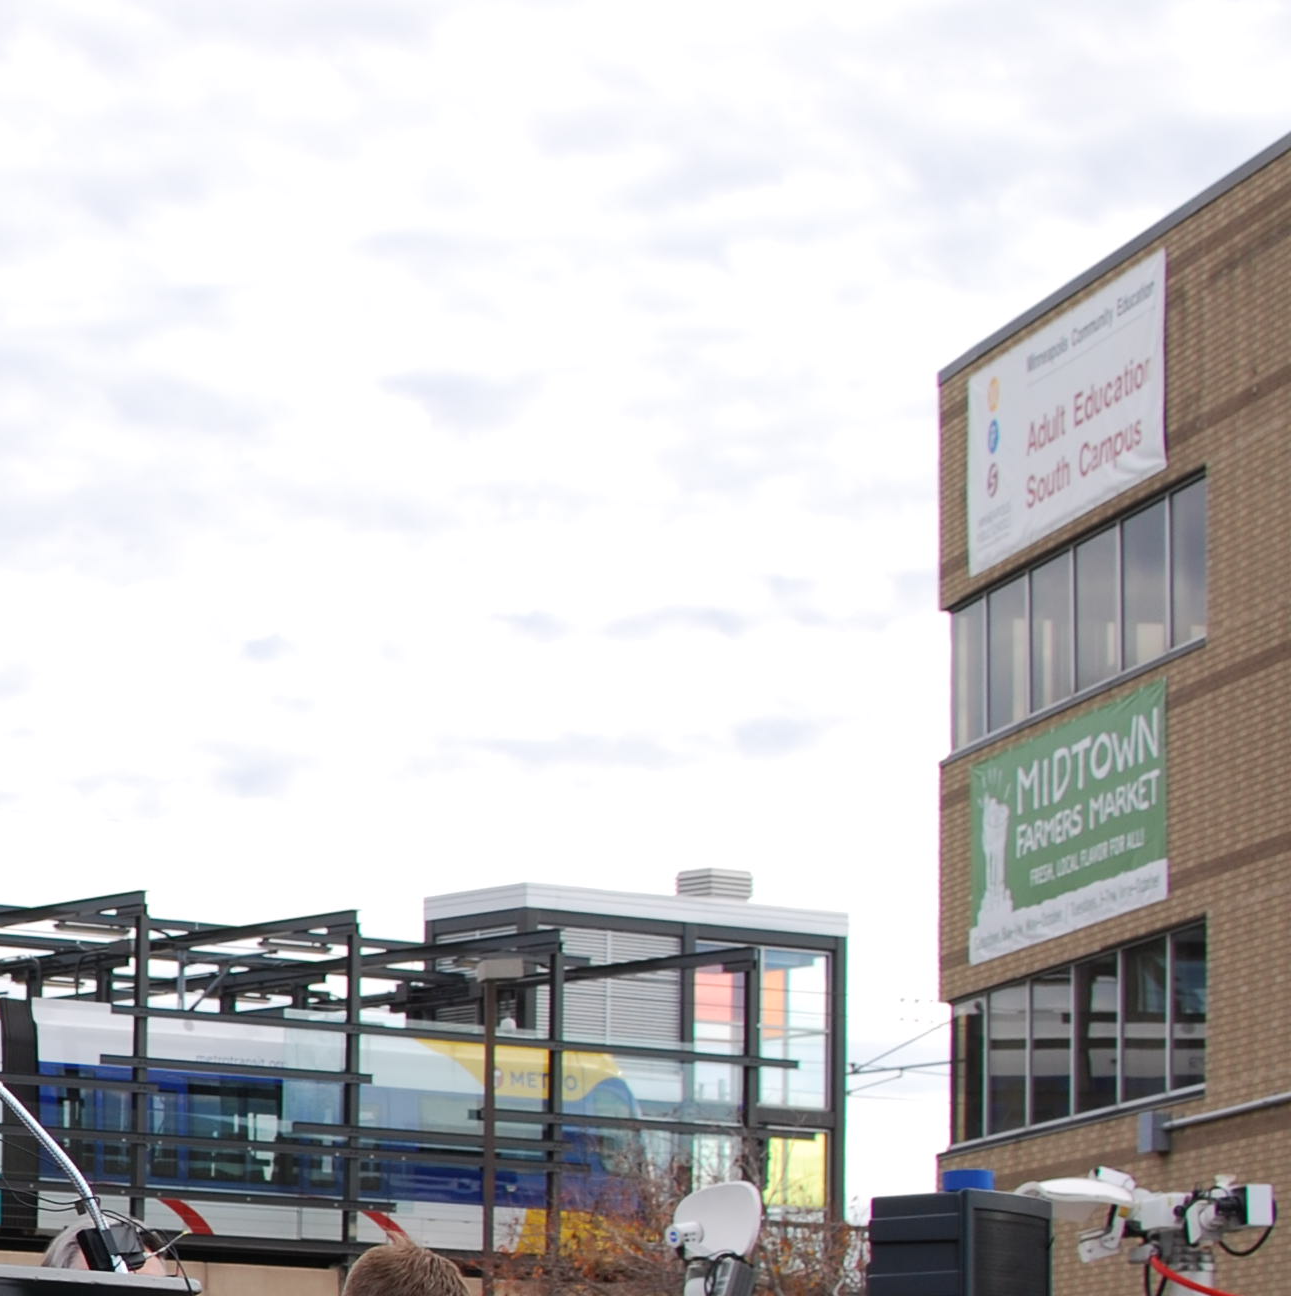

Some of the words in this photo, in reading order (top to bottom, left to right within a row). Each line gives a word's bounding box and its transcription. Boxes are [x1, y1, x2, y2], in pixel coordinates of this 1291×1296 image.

[1026, 456, 1070, 509] South
[1079, 419, 1142, 479] Campus
[1027, 404, 1066, 457] Adult
[1016, 706, 1160, 816] MIDTOWN
[1016, 803, 1083, 859] FARMERS
[1089, 768, 1161, 830] MARKET
[510, 1071, 577, 1092] METO
